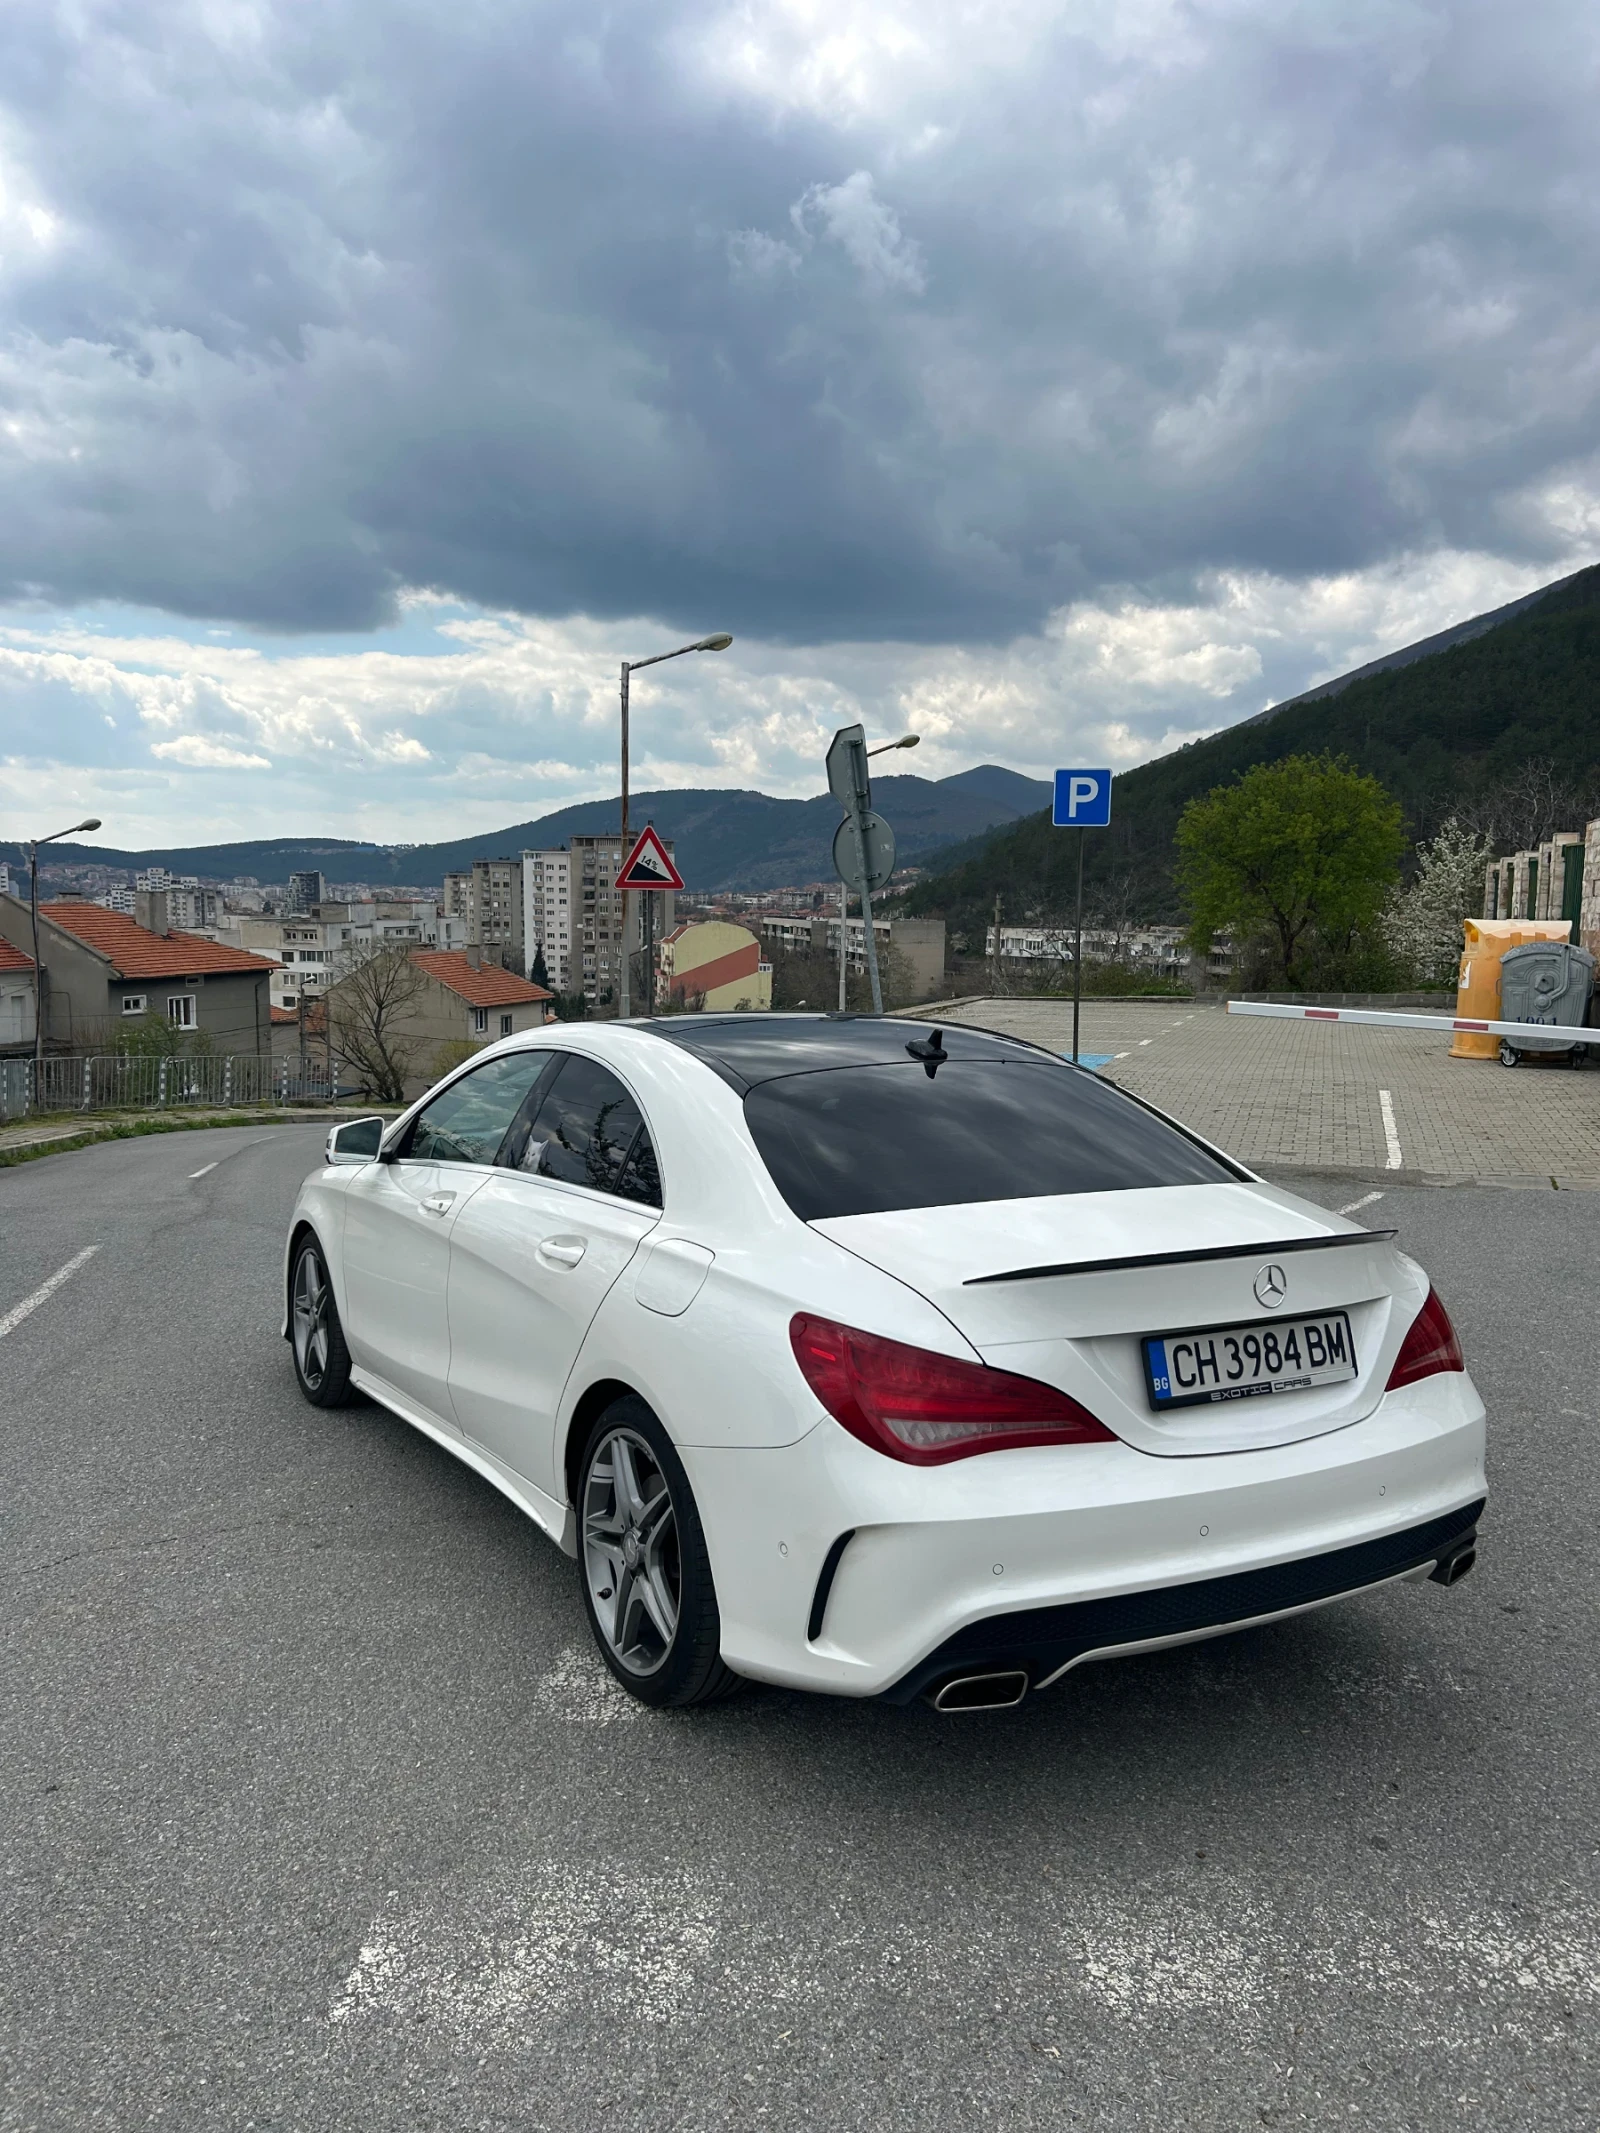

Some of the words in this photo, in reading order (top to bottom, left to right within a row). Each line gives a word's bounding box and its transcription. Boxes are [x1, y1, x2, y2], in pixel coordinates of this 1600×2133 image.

[1069, 777, 1099, 818] P
[641, 855, 659, 871] 14%
[1172, 1340, 1220, 1388] CH
[1223, 1328, 1302, 1380] 3984
[1304, 1322, 1347, 1367] BM
[1153, 1377, 1169, 1391] BG
[1210, 1384, 1270, 1401] EXOTIC
[1274, 1377, 1312, 1391] CARS
